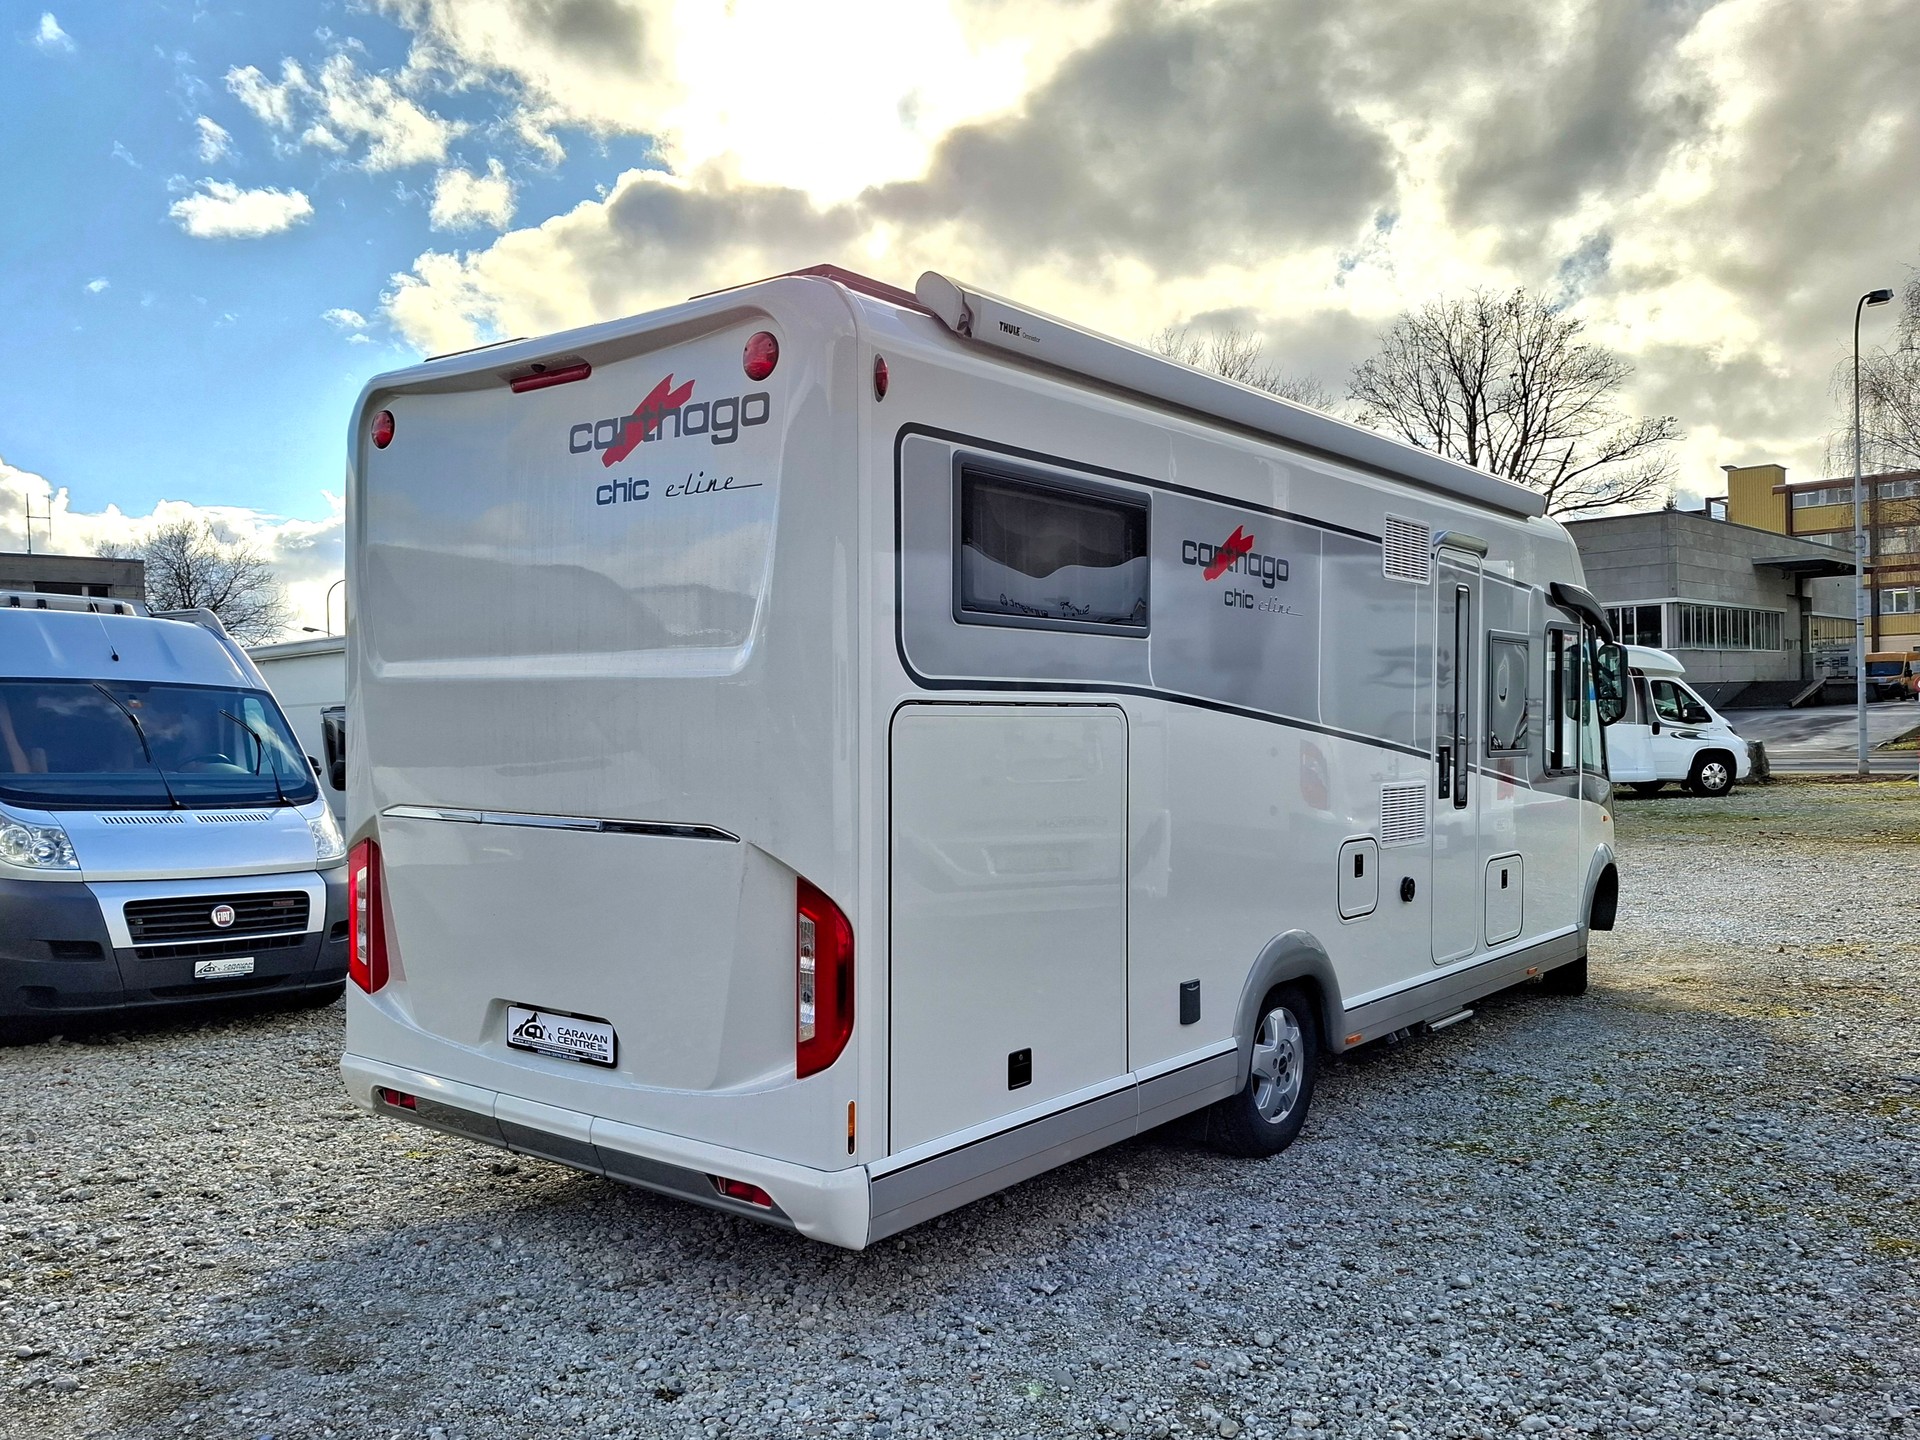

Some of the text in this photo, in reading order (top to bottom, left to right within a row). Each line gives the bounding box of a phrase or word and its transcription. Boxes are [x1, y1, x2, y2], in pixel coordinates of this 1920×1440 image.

[999, 321, 1020, 336] THULE
[569, 391, 770, 454] carthago
[596, 471, 763, 506] chic e-line
[1182, 539, 1289, 589] carthago
[1224, 587, 1254, 609] chic
[217, 911, 230, 922] FIAT
[557, 1027, 608, 1044] CARAVAN
[557, 1036, 597, 1051] CENTRE
